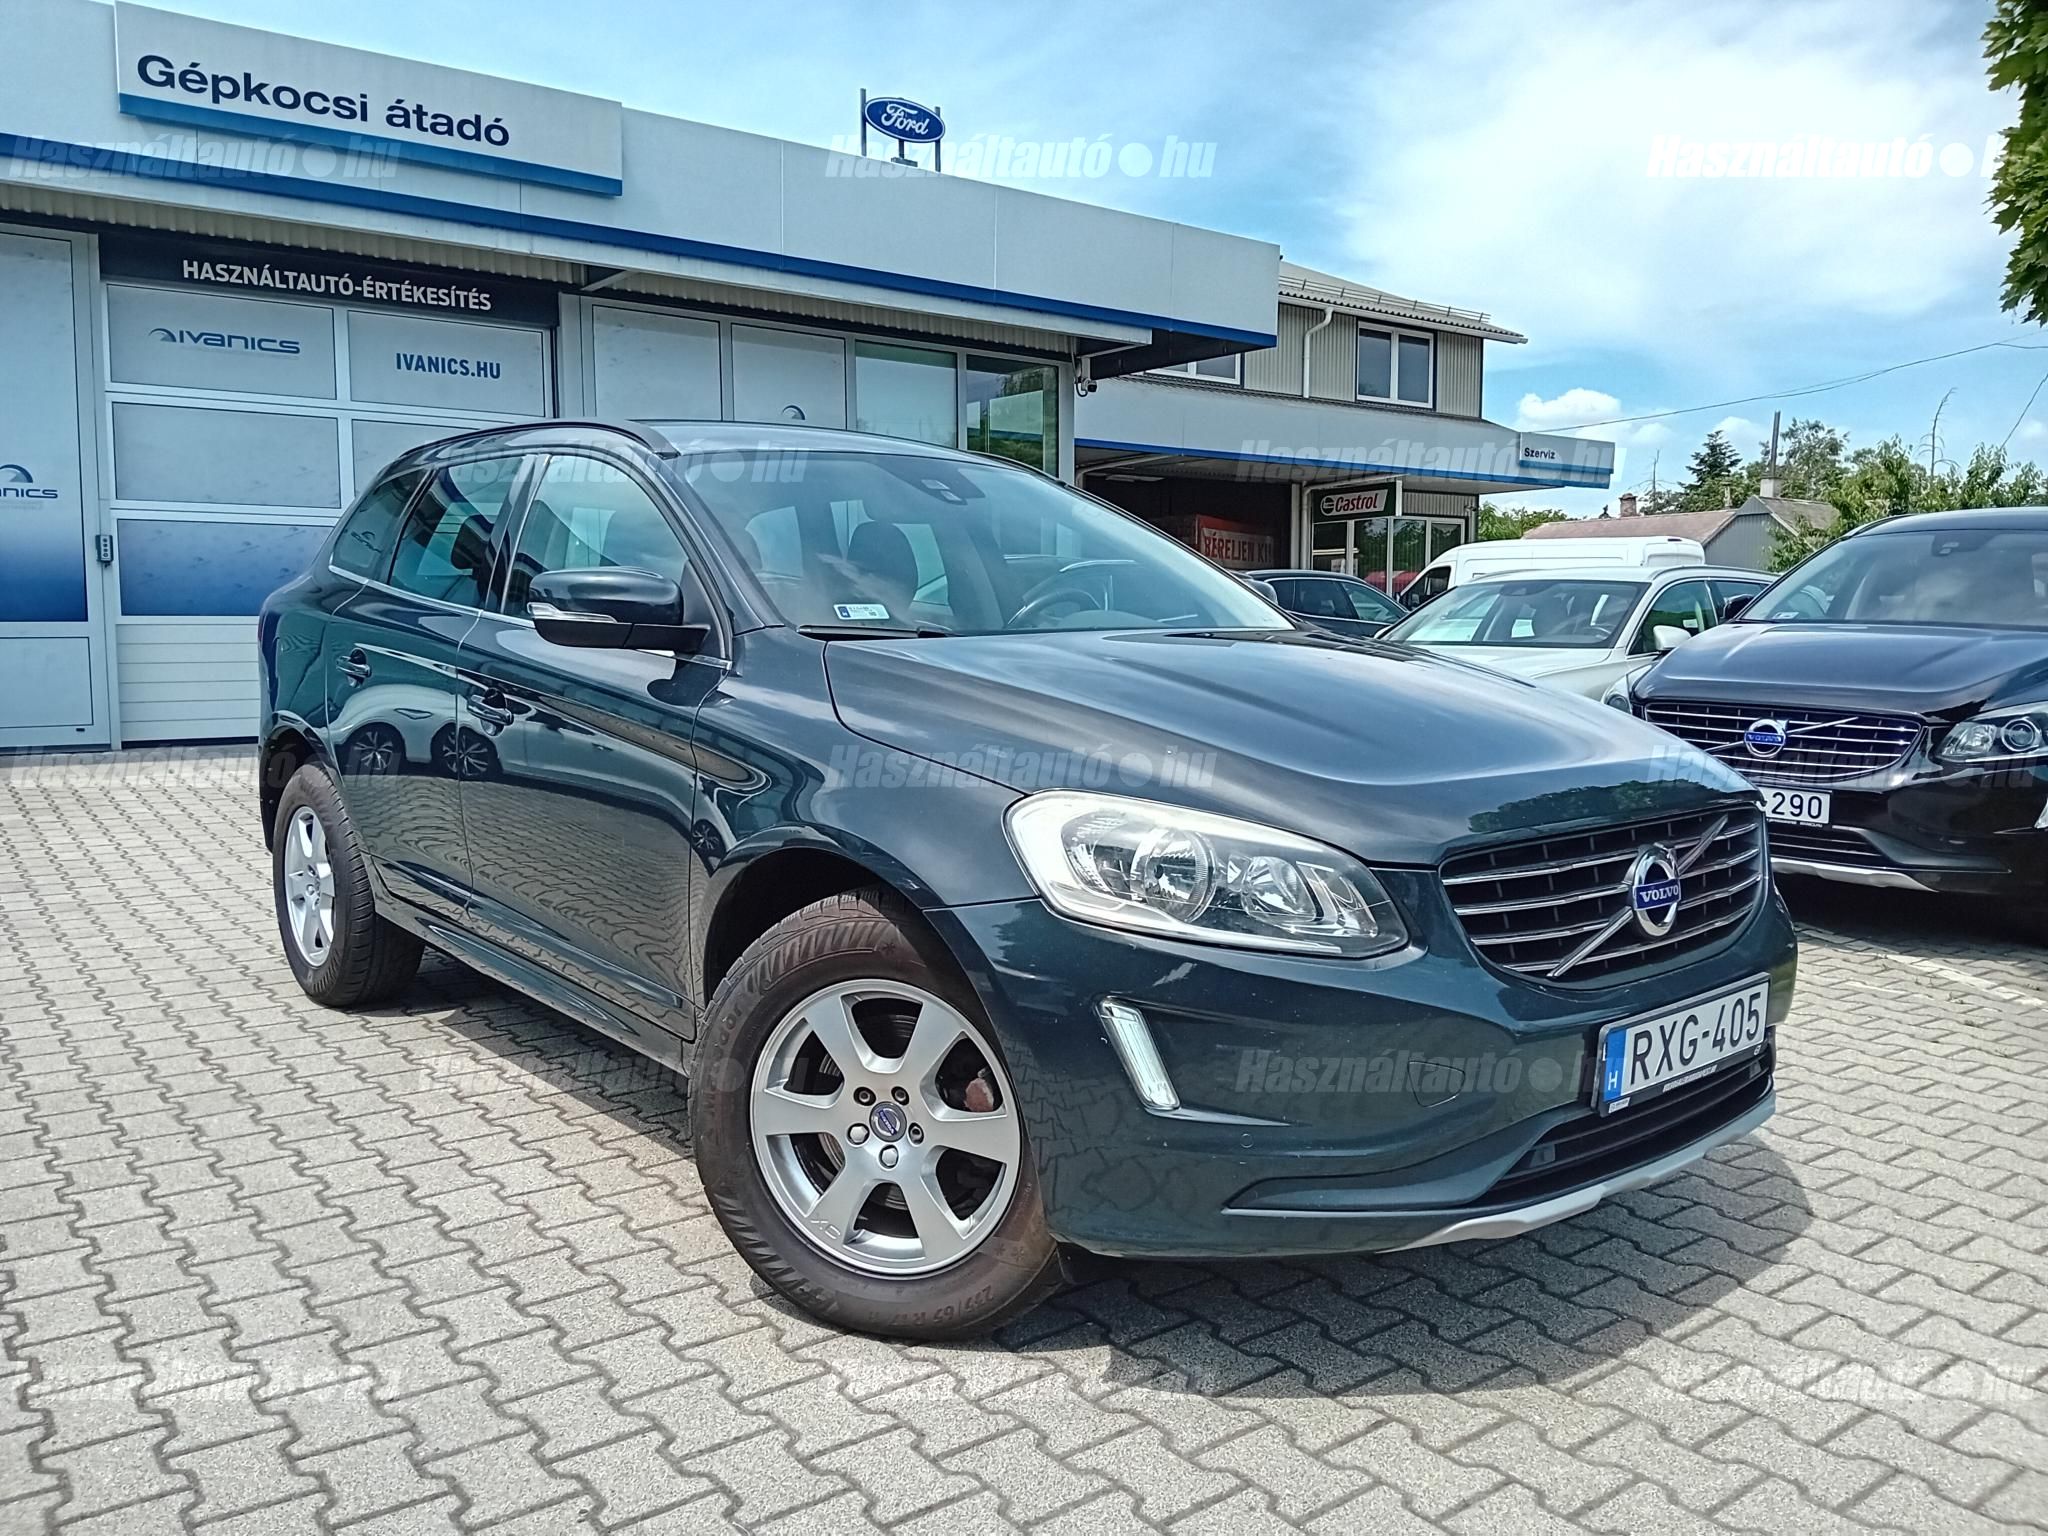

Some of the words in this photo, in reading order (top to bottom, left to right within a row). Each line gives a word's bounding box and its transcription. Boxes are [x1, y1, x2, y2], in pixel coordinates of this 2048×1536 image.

[137, 55, 368, 122] Gépkocsi
[385, 98, 510, 147] átadó
[881, 103, 930, 135] Ford
[182, 259, 492, 312] HASZNÁLTAUTÓ-ÉRTÉKESÍTÉS
[395, 352, 501, 380] IVANICS.HU
[1524, 447, 1556, 460] Szerviz
[1335, 492, 1379, 513] Castrol
[1640, 885, 1679, 902] VOLVO
[1631, 992, 1762, 1086] RXG-405
[1607, 1070, 1619, 1091] H
